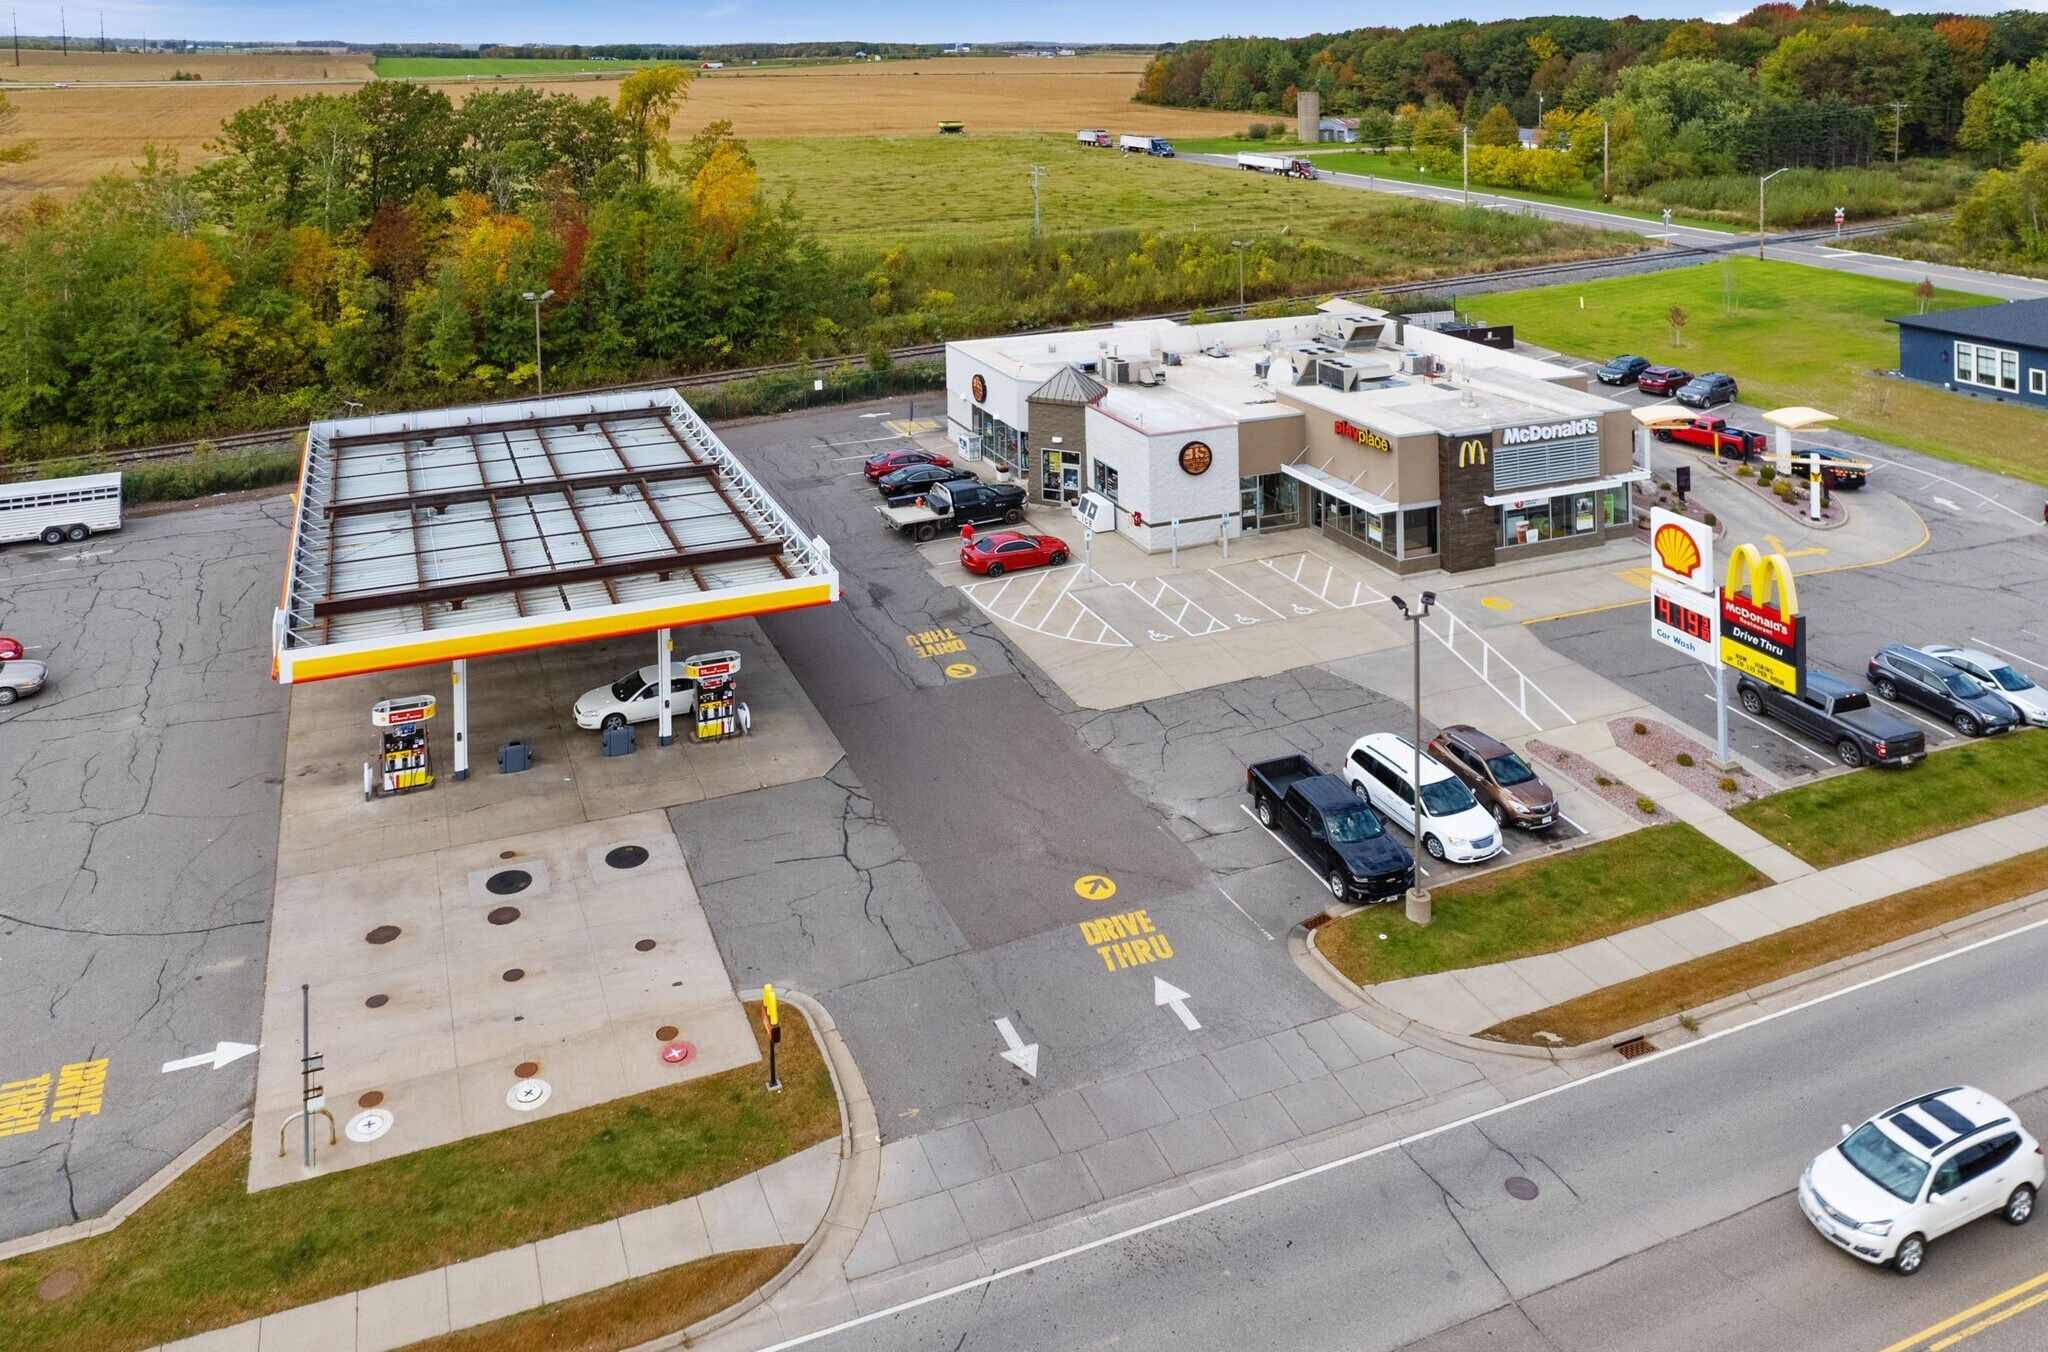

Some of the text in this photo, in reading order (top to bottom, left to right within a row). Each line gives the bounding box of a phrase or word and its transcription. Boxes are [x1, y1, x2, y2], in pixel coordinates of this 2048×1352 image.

[1334, 420, 1389, 453] playplace
[1502, 418, 1599, 446] McDonald's
[1725, 601, 1789, 636] McDonald's
[1738, 616, 1774, 636] Restaurant
[905, 627, 957, 648] THRU
[914, 639, 968, 659] DRIVE
[1656, 628, 1696, 652] Car Wash
[1732, 626, 1784, 656] Drive Thru
[1079, 909, 1157, 946] DRIVE
[1096, 934, 1174, 973] THRU
[50, 1057, 109, 1123] DRIVE
